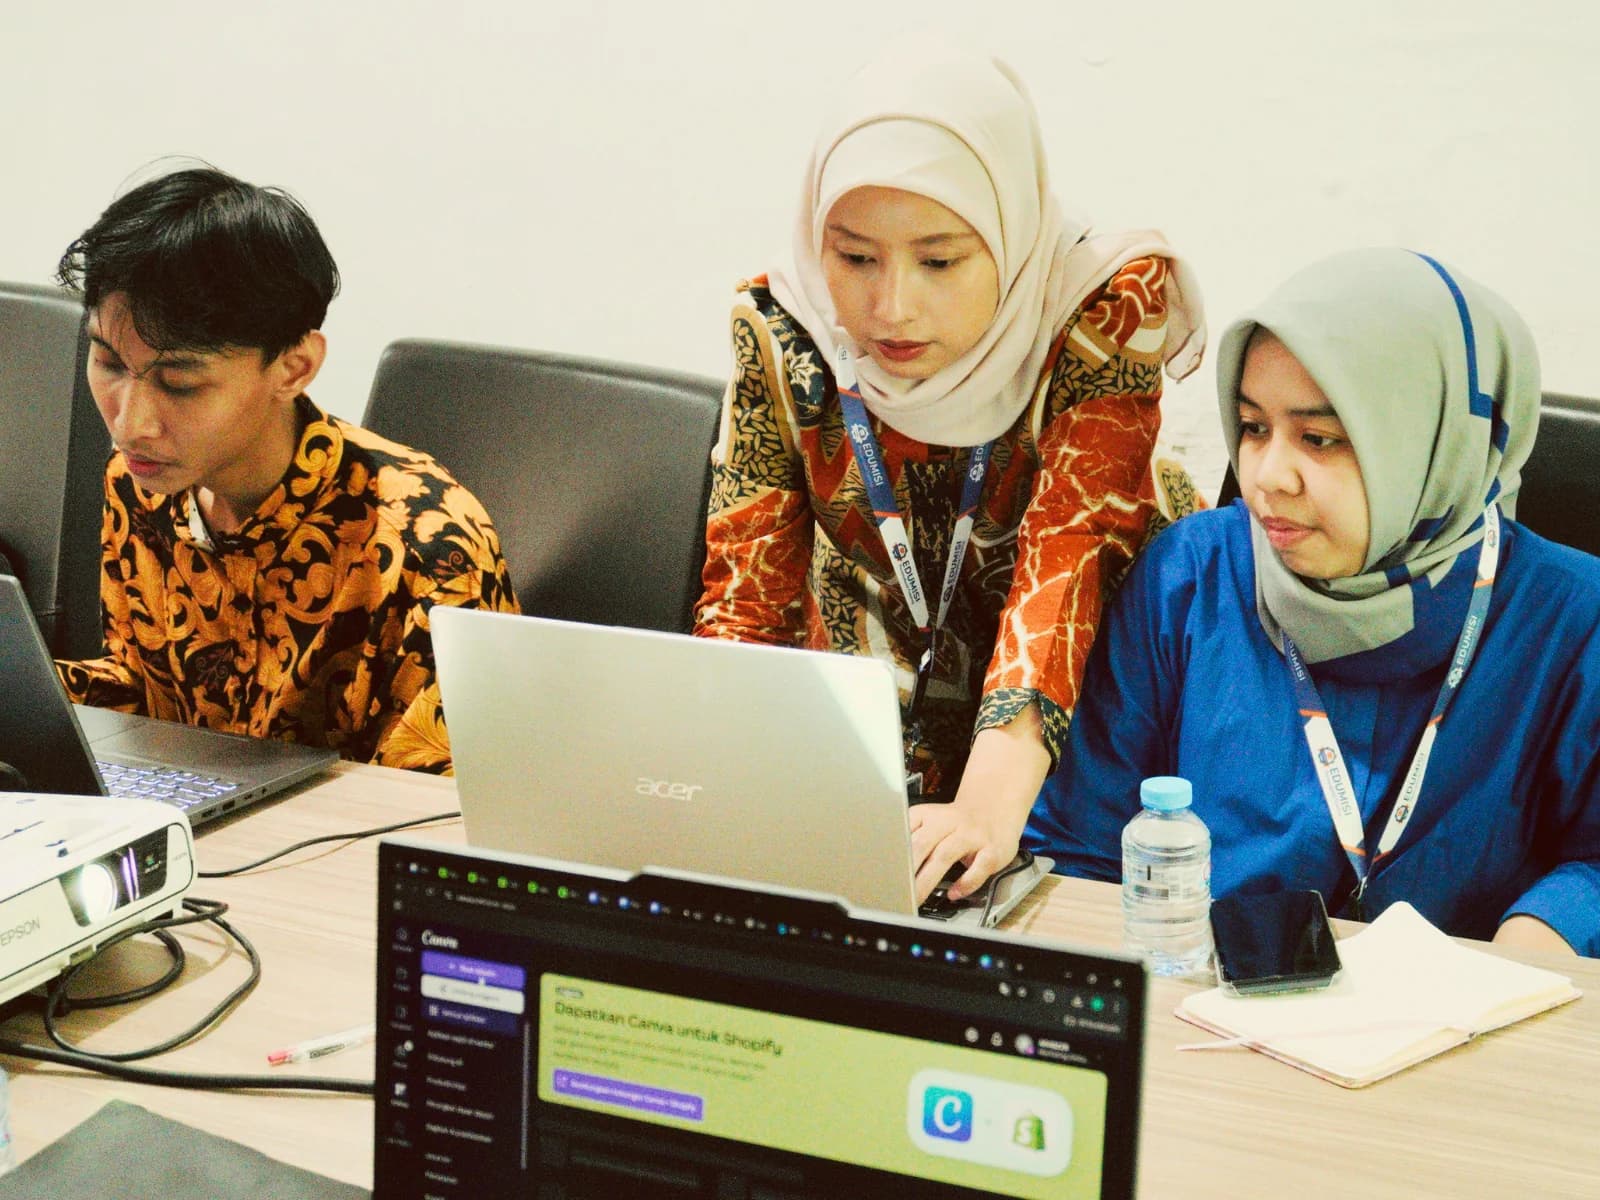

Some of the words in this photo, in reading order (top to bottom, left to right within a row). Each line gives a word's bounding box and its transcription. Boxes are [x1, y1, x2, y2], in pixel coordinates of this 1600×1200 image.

[862, 442, 885, 486] EDUMISI
[902, 560, 921, 602] EDUMISI
[1288, 639, 1307, 680] DUMISI
[1456, 615, 1478, 666] EDUMISI
[636, 778, 703, 801] acer
[1329, 767, 1352, 816] EDUMISI
[0, 915, 40, 946] EPSON
[554, 1001, 625, 1026] Dapatkan
[627, 1014, 674, 1036] Canva
[677, 1025, 720, 1043] untuk
[724, 1032, 784, 1057] Shopify
